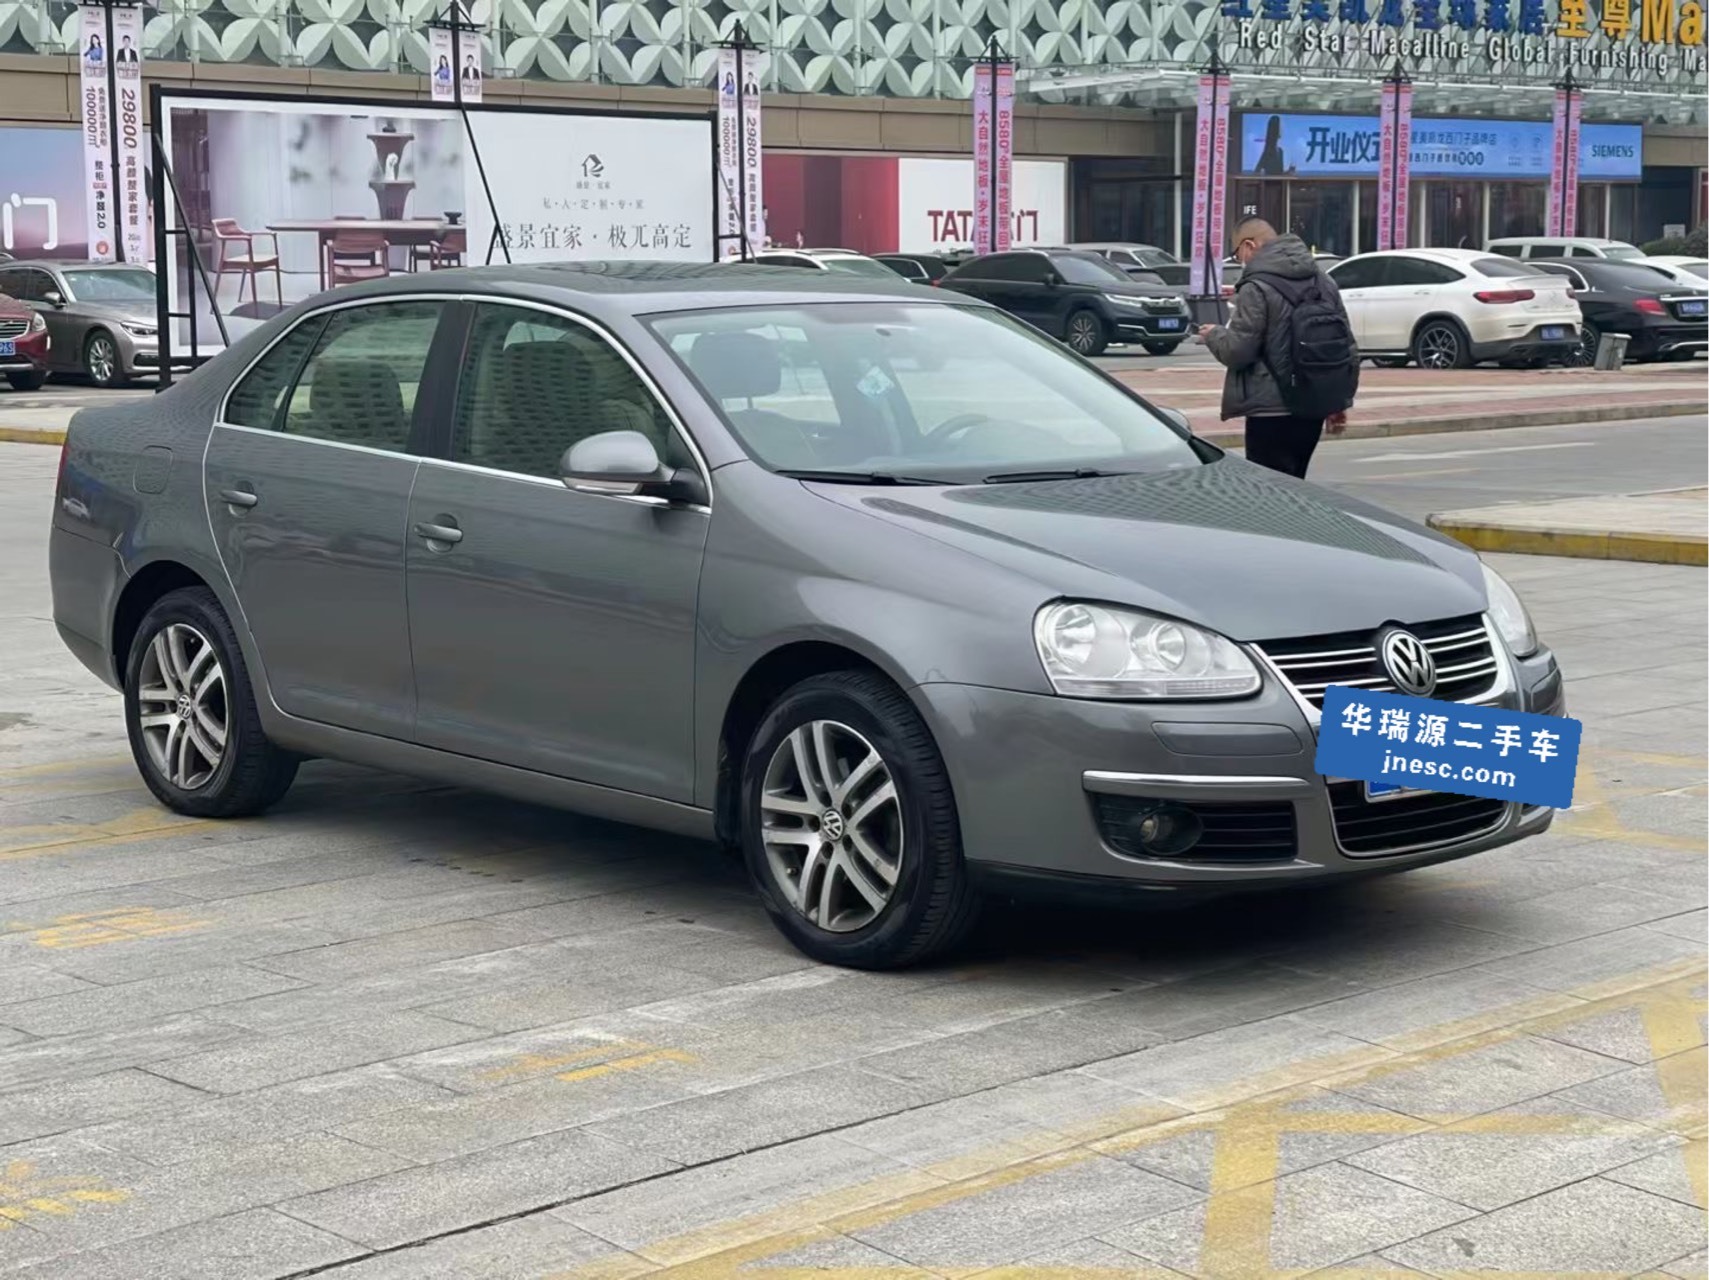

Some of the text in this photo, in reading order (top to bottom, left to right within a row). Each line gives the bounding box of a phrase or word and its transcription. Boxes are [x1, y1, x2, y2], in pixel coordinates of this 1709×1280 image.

[1240, 22, 1282, 49] Red
[1304, 26, 1350, 52] Star
[1370, 29, 1469, 59] Macalline
[1489, 36, 1552, 63] Global
[1569, 42, 1668, 75] Furnishing
[1592, 144, 1634, 159] SIEMENS
